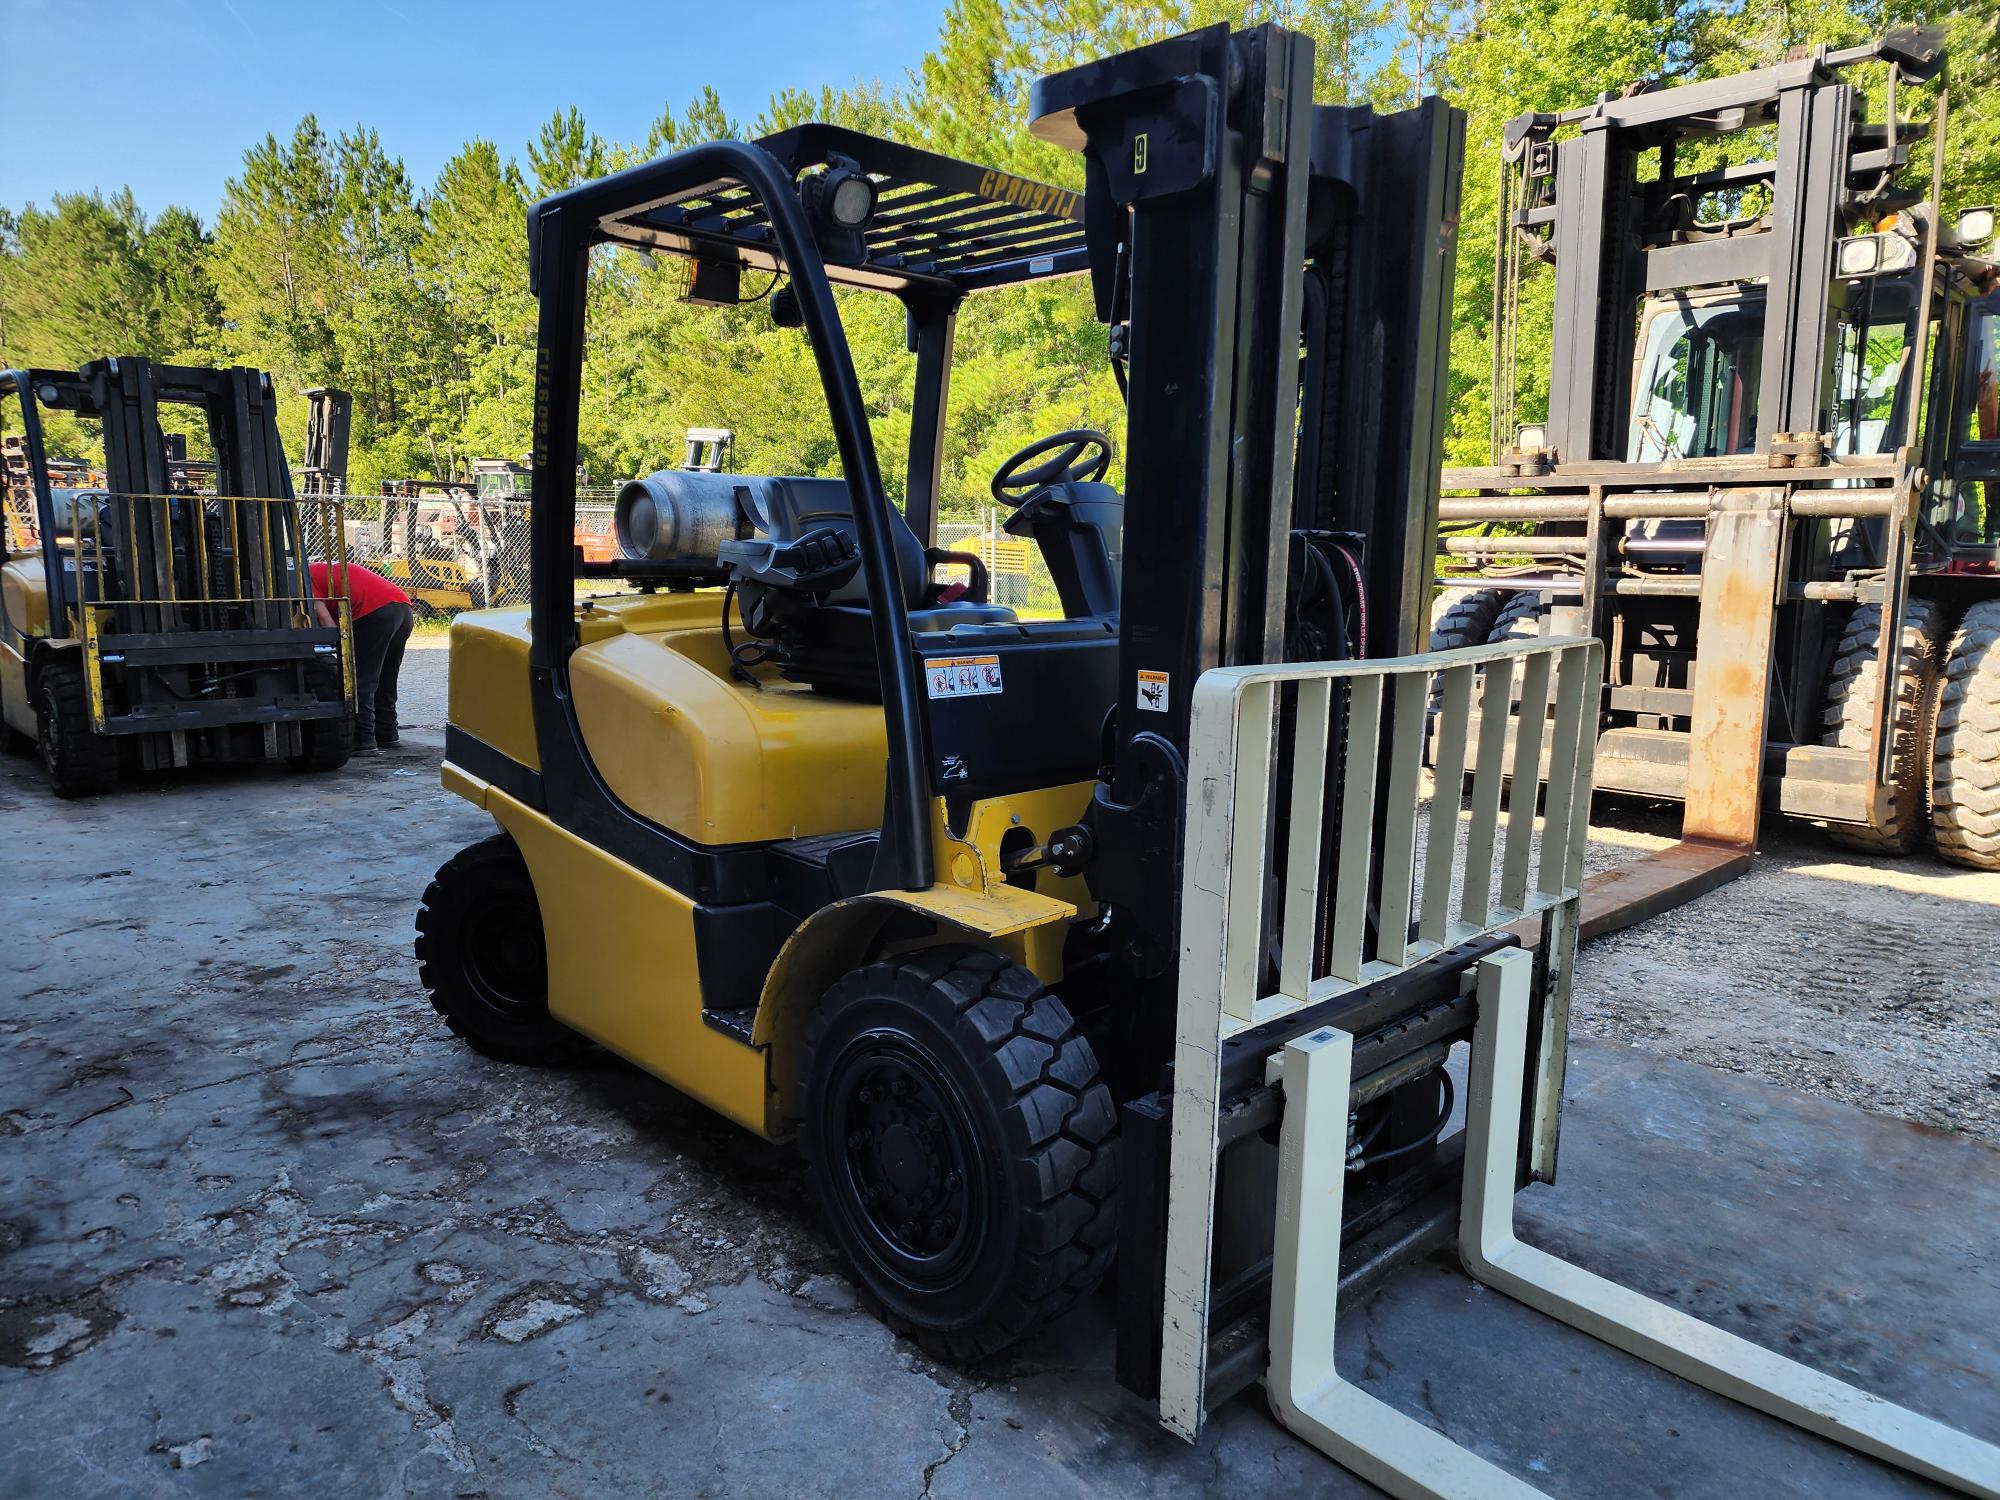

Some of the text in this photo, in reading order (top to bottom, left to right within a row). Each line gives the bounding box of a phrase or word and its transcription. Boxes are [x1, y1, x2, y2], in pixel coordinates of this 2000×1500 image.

[1135, 135, 1145, 171] 9
[1830, 321, 1846, 435] TAYLO
[1145, 674, 1167, 682] WARNING
